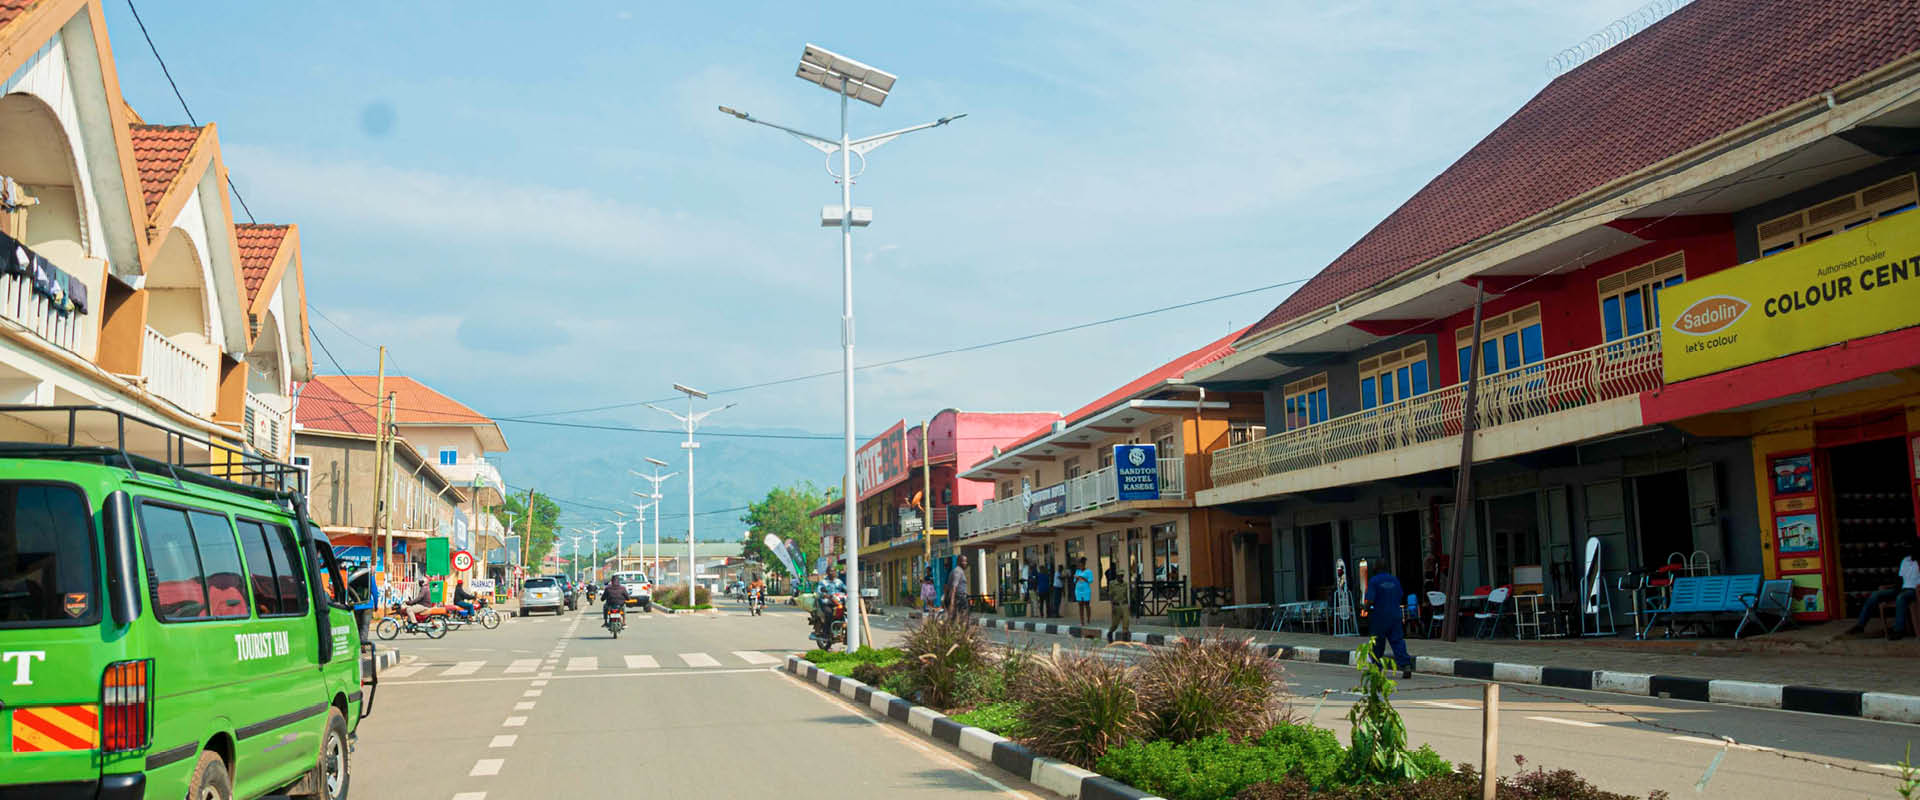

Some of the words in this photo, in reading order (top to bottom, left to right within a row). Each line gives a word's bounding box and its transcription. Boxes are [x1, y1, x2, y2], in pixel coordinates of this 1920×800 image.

[1817, 258, 1858, 277] Authorised
[1859, 250, 1886, 265] Dealer
[1764, 276, 1853, 318] COLOUR
[1859, 255, 1920, 291] CENT
[1684, 303, 1737, 329] Sadolin
[1685, 341, 1705, 353] let's
[1706, 334, 1738, 349] colour
[856, 429, 905, 497] ORTEBET
[457, 556, 469, 565] 50
[471, 580, 493, 588] PHARMACY
[234, 632, 272, 661] TOURIST
[273, 630, 289, 656] VAN
